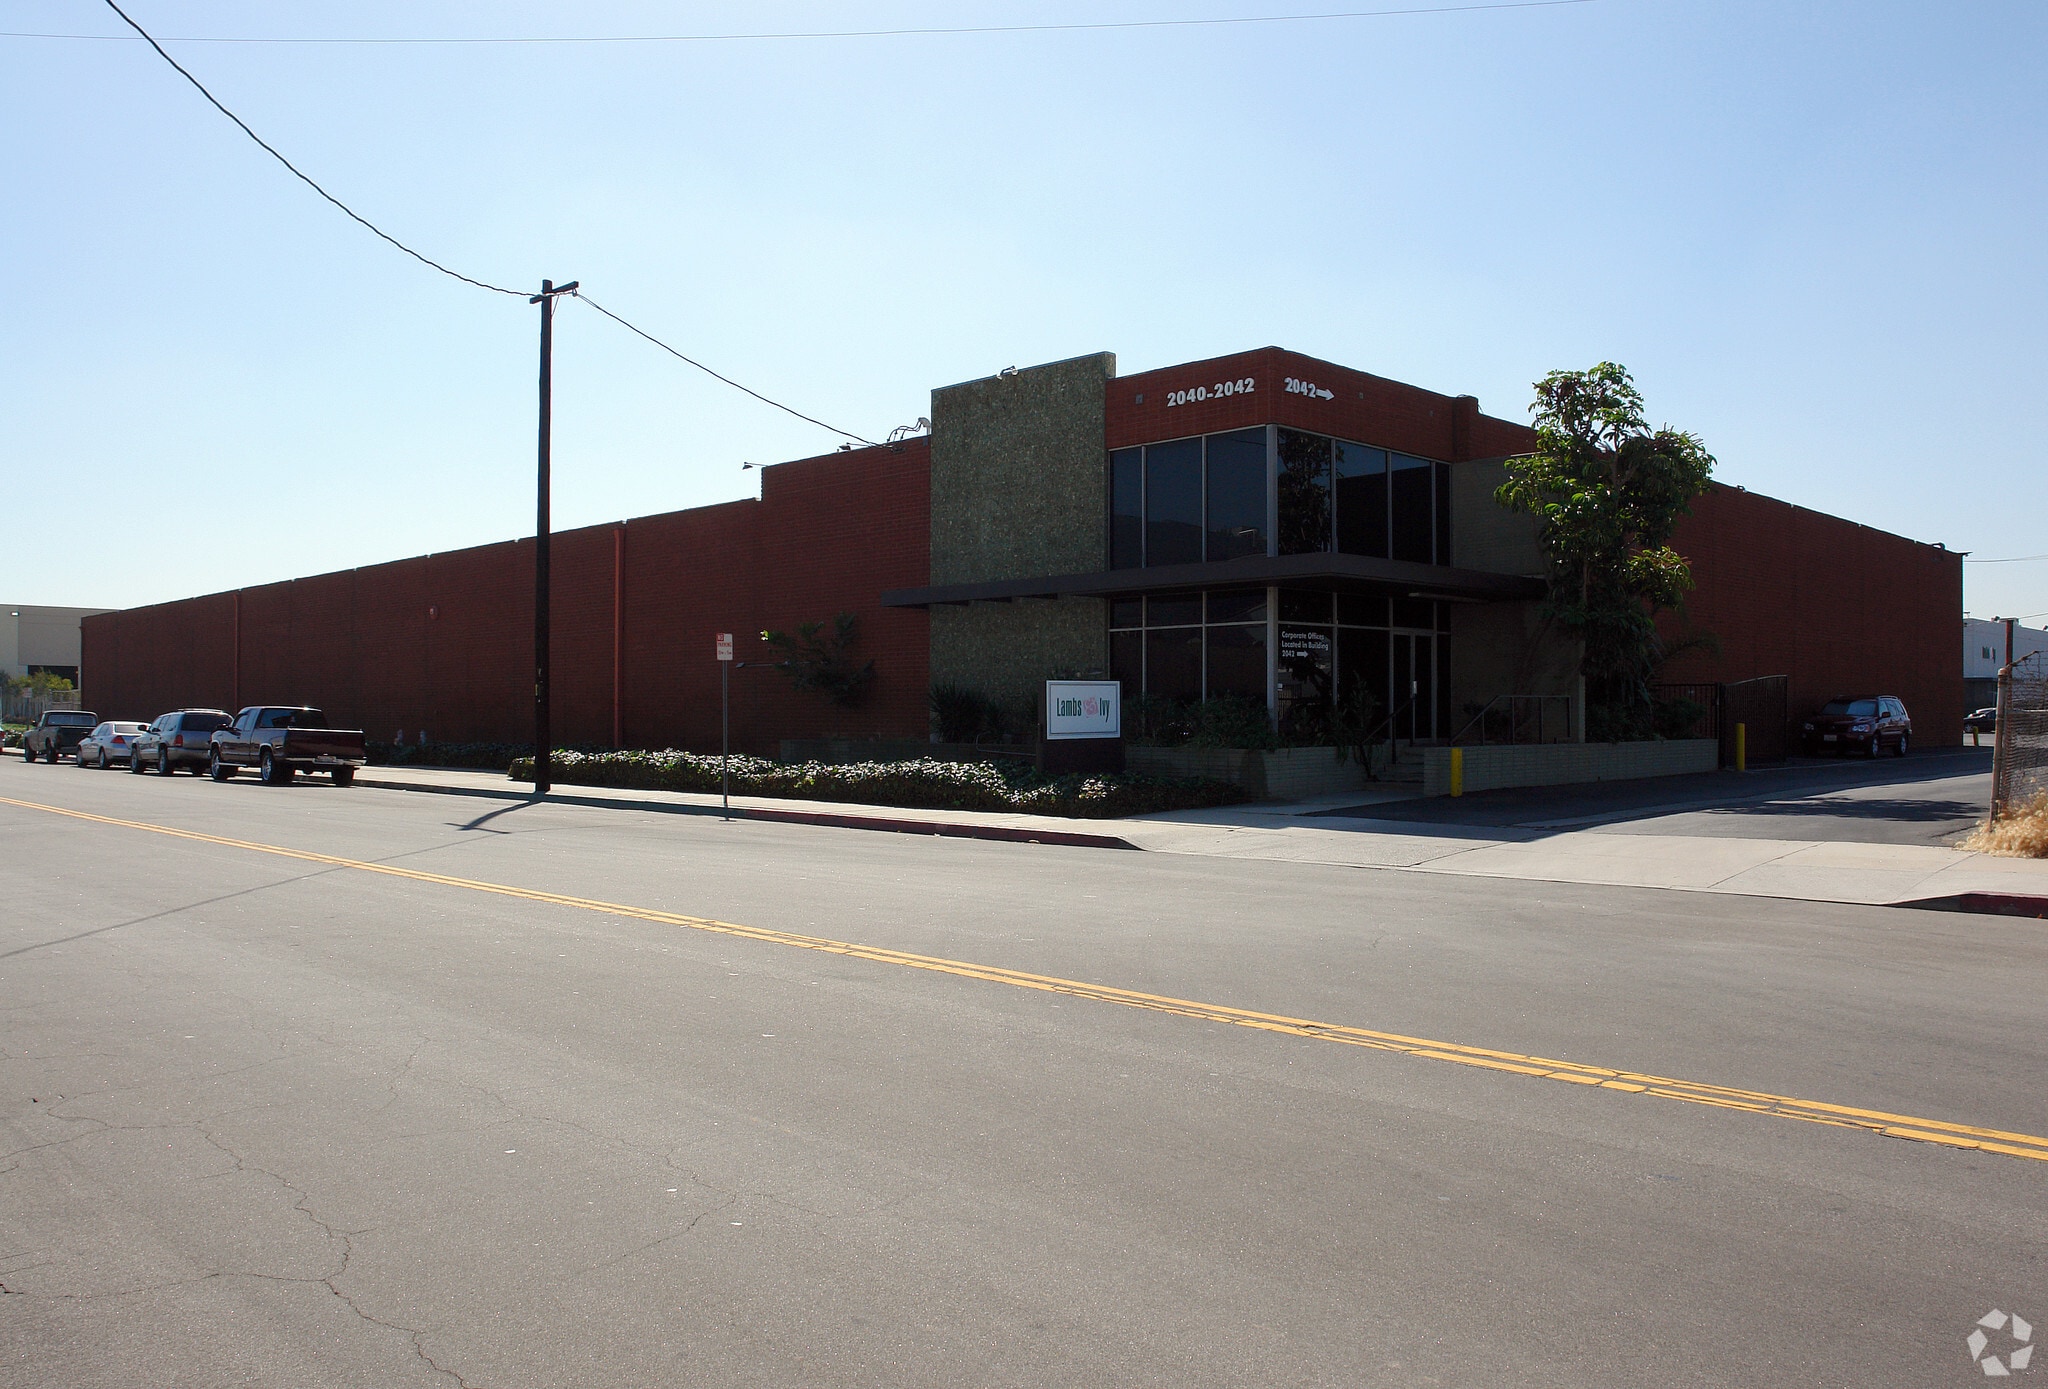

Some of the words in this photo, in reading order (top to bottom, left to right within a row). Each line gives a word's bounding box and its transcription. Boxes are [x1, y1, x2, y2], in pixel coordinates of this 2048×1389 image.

[1166, 377, 1255, 407] 2040-2042
[1284, 377, 1316, 398] 2042
[1281, 631, 1307, 640] Corporate
[1307, 632, 1325, 640] Offices
[1281, 640, 1301, 648] Located
[1308, 641, 1329, 651] Building
[1056, 697, 1082, 717] Lambs
[1099, 697, 1110, 723] Ivy
